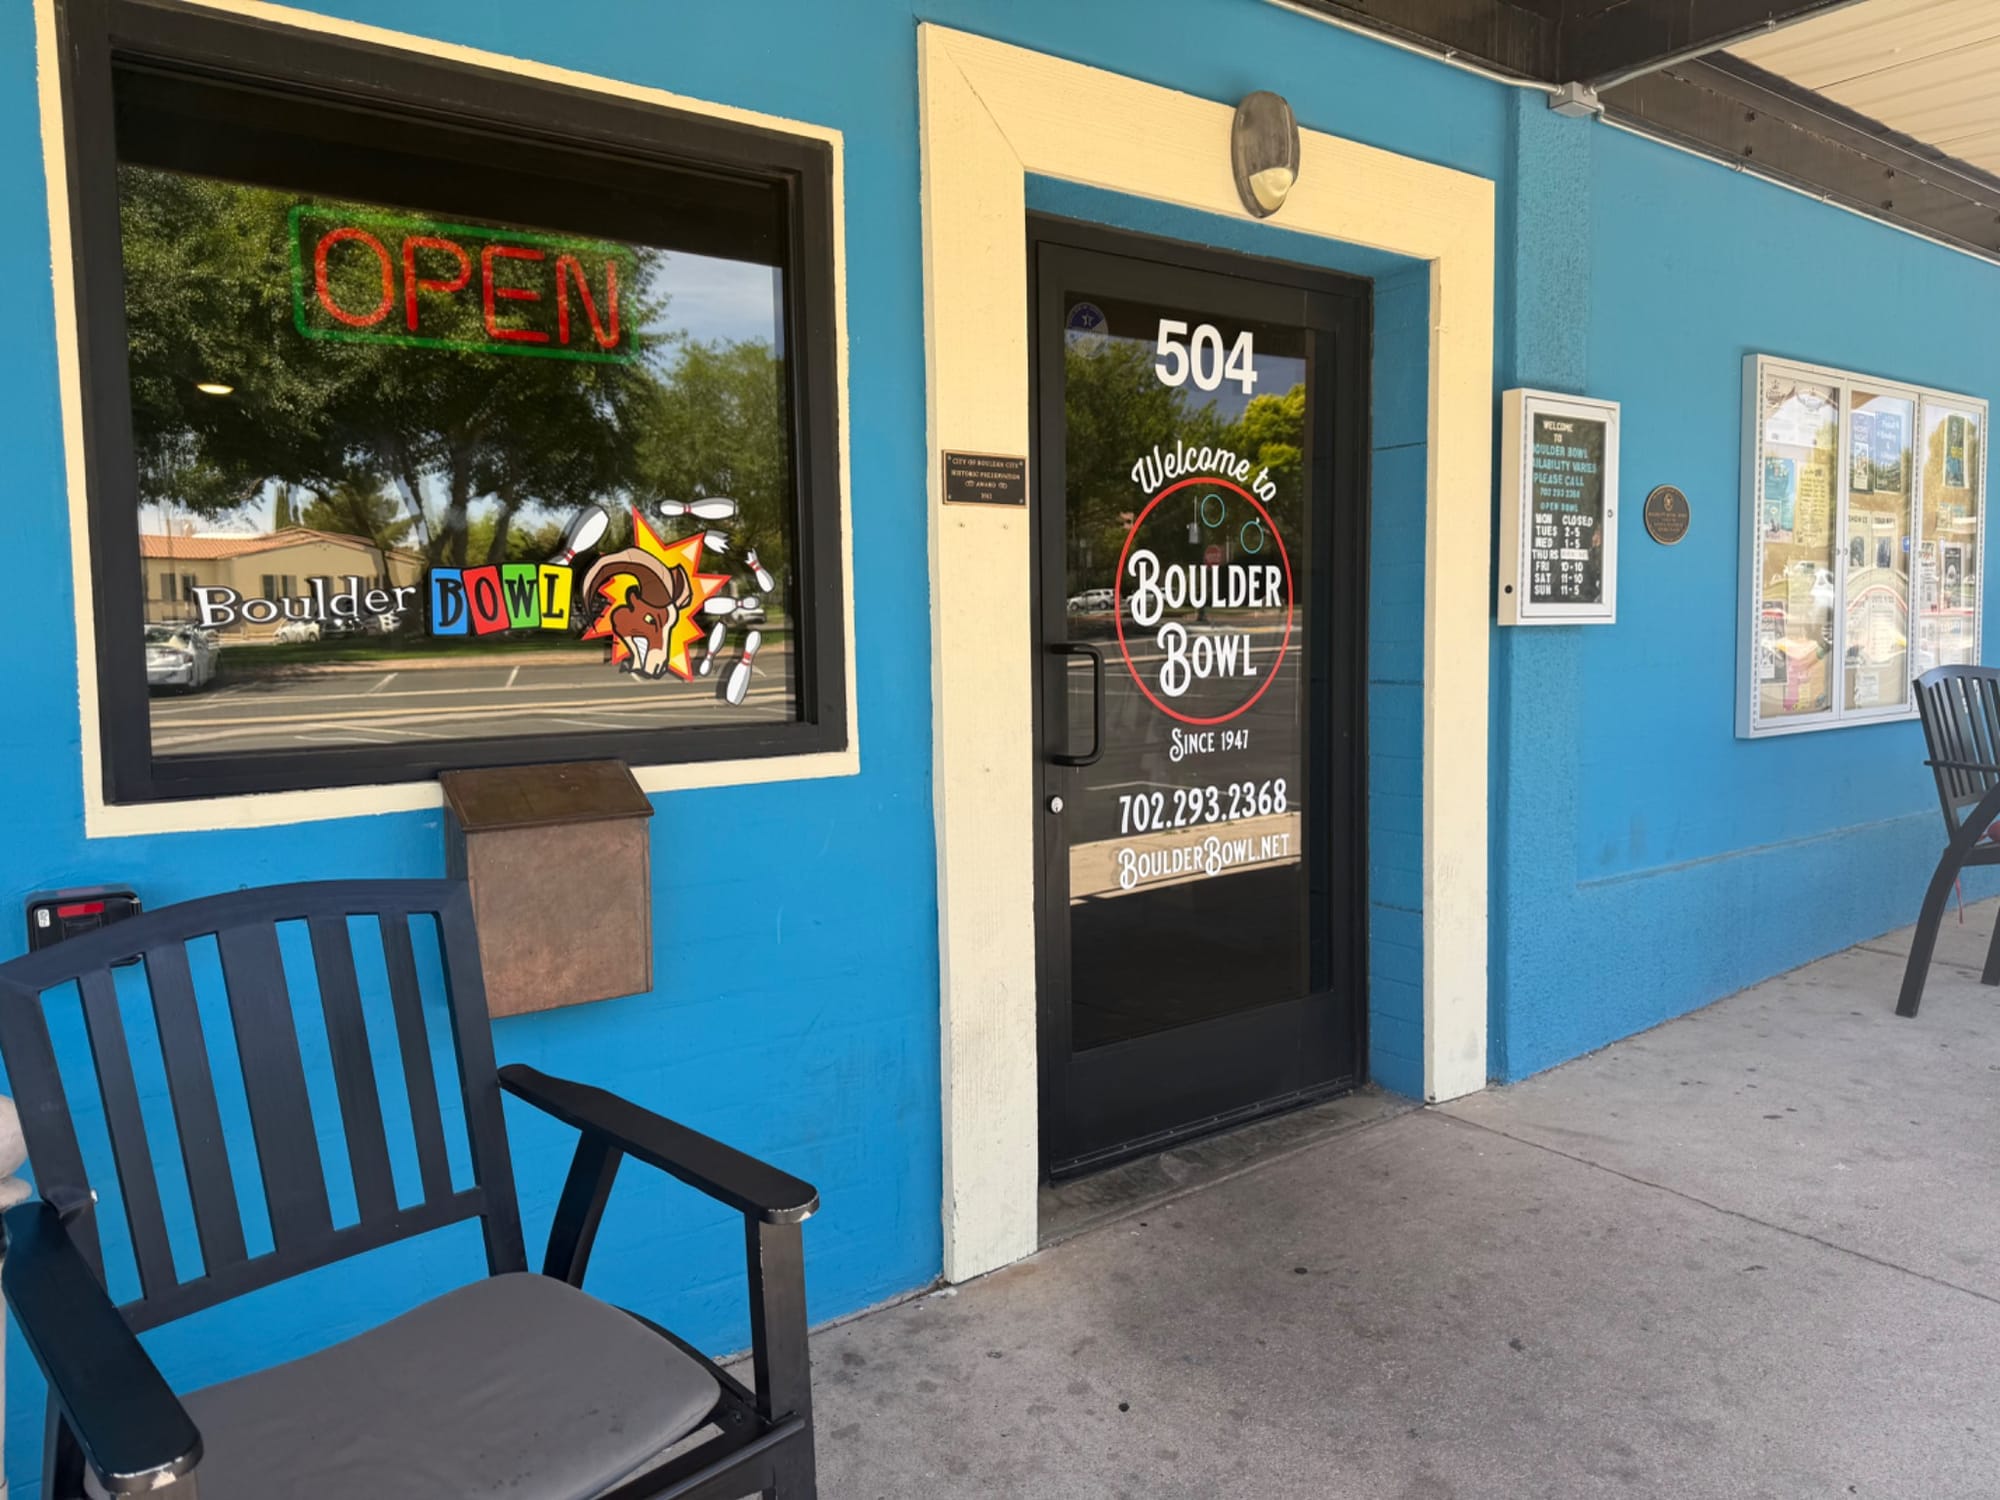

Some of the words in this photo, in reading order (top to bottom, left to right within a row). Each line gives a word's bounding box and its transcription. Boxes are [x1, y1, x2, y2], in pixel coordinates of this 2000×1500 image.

[314, 226, 621, 350] OPEN
[1154, 318, 1258, 395] 504
[1543, 421, 1574, 432] WELCOME
[1554, 433, 1562, 443] TO
[1533, 443, 1565, 457] OULDER
[1567, 446, 1589, 459] BOWL
[1131, 440, 1249, 494] Welcome
[1252, 466, 1278, 502] to
[1533, 472, 1563, 485] PLEASE
[1564, 475, 1585, 487] CALL
[1536, 513, 1552, 524] MON
[1561, 514, 1594, 527] CLOSED
[1536, 525, 1557, 536] TUES
[1535, 537, 1553, 548] WED
[1536, 561, 1549, 571] FRI
[1534, 573, 1551, 583] SAT
[1127, 549, 1283, 627] BOULDER
[1534, 584, 1551, 595] SUN
[191, 574, 417, 629] Boulder
[434, 570, 570, 630] BOWL
[1156, 622, 1258, 698] BOWL
[1169, 727, 1216, 763] SINCE
[1220, 729, 1249, 753] 1947
[1119, 778, 1288, 834] 702.293.2368
